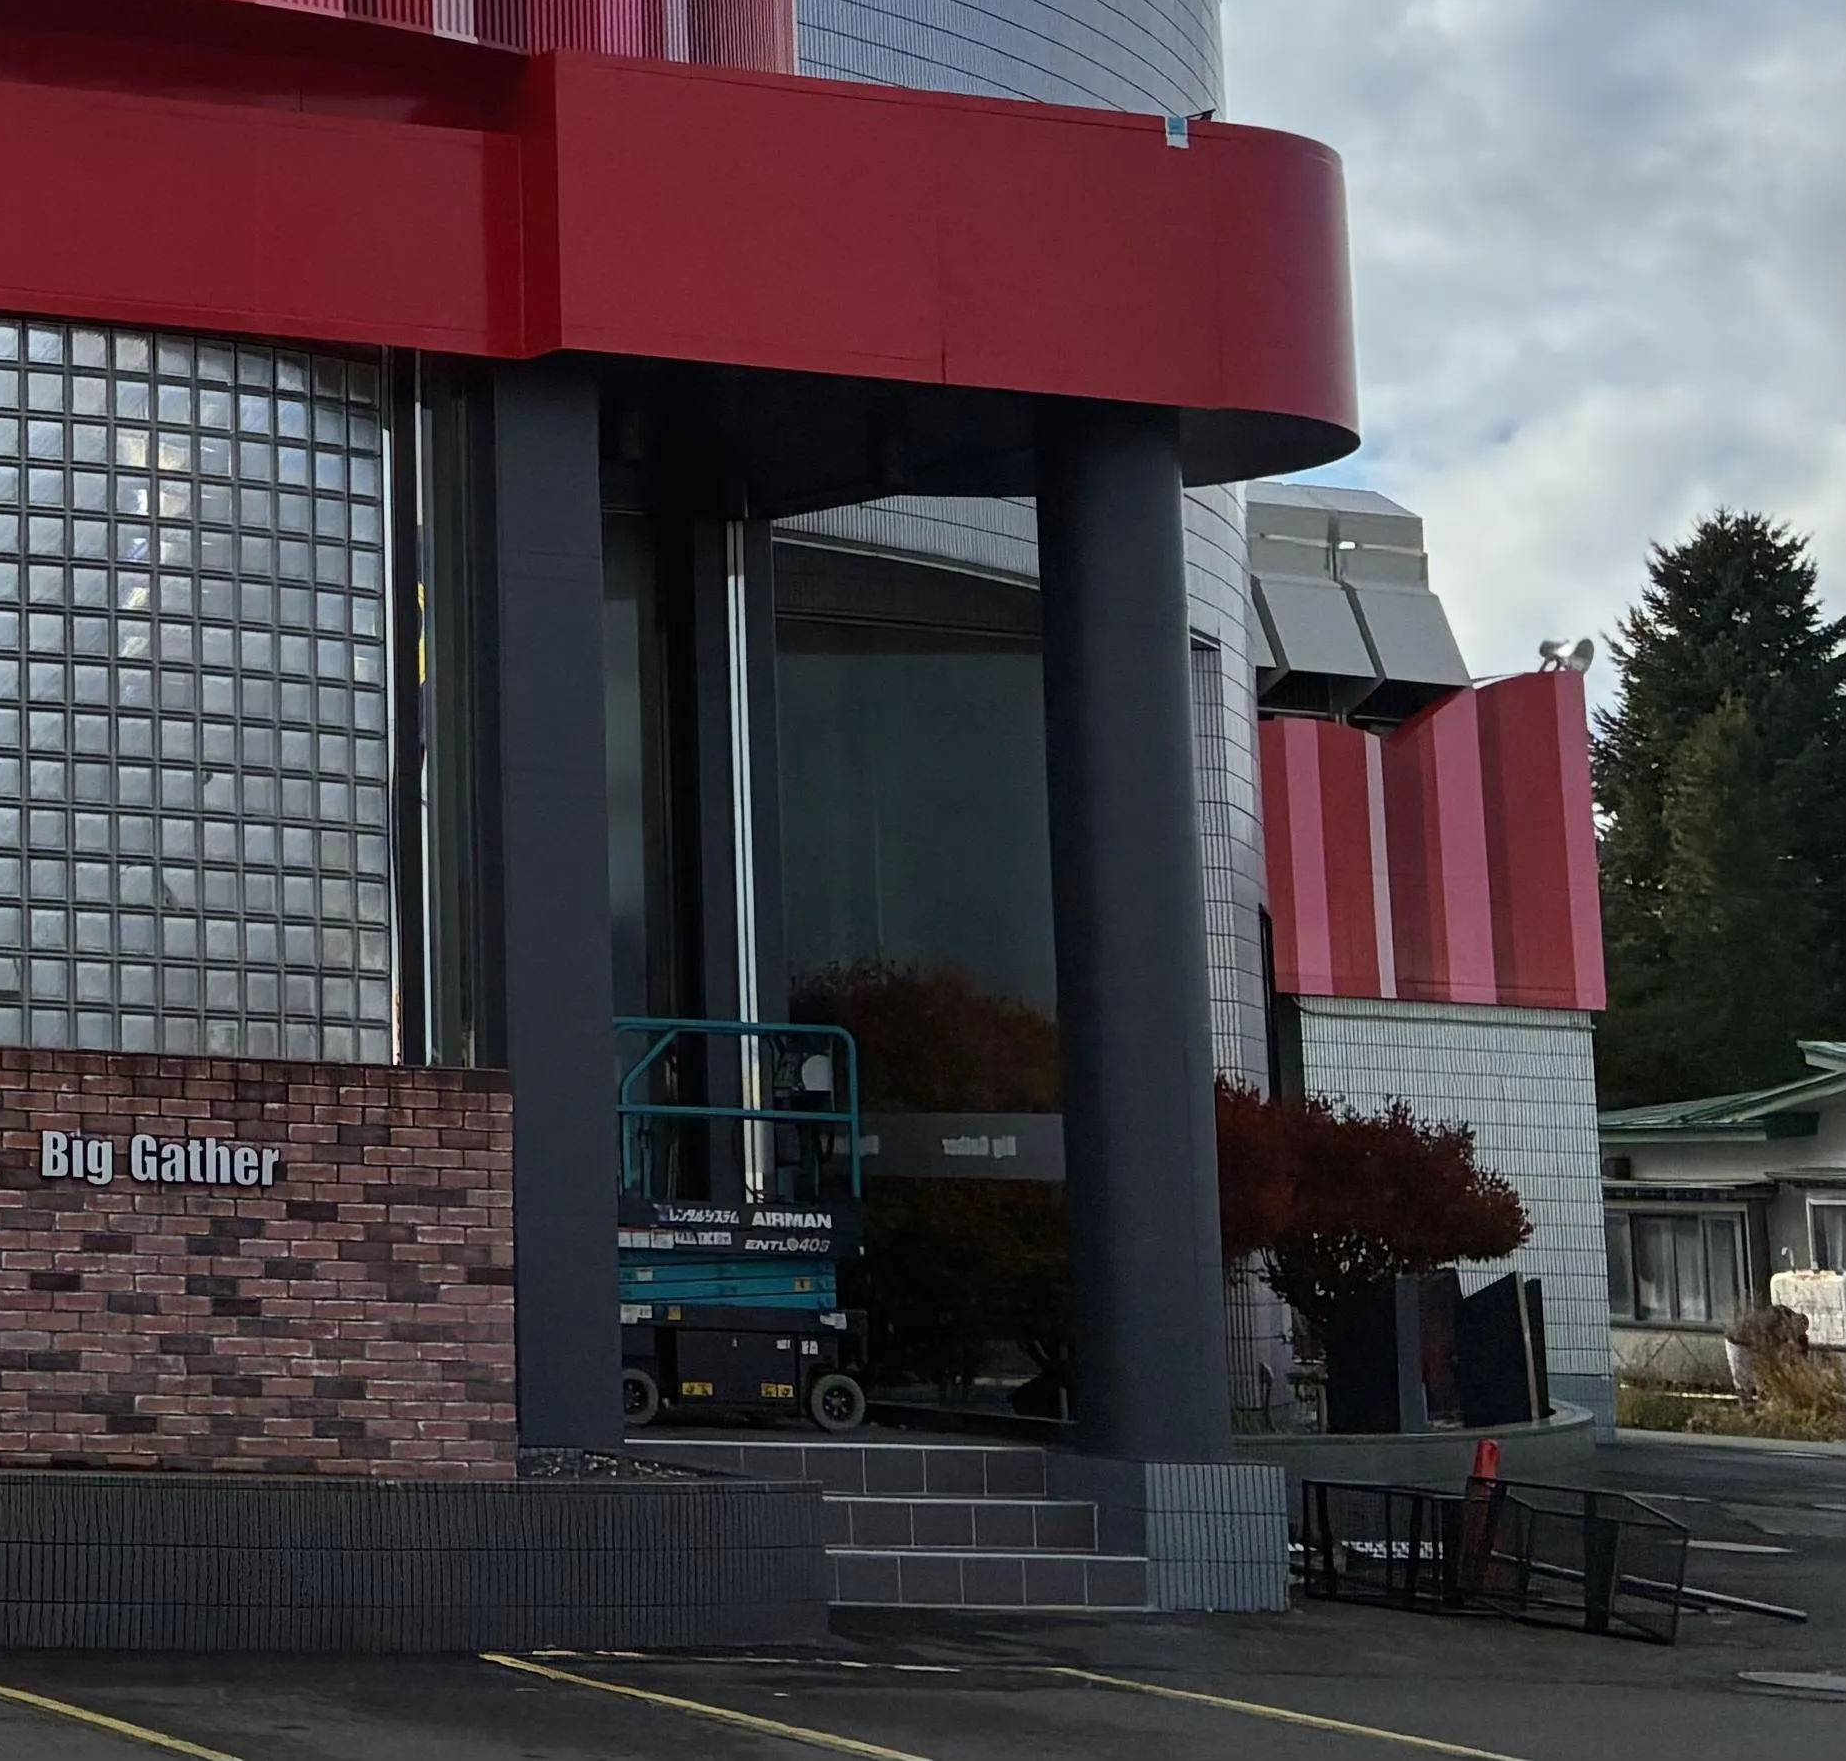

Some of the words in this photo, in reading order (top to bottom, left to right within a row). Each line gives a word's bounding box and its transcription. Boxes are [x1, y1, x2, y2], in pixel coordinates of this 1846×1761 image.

[41, 1130, 113, 1185] Big
[130, 1133, 280, 1187] Gather
[752, 1211, 832, 1229] AIRMAN
